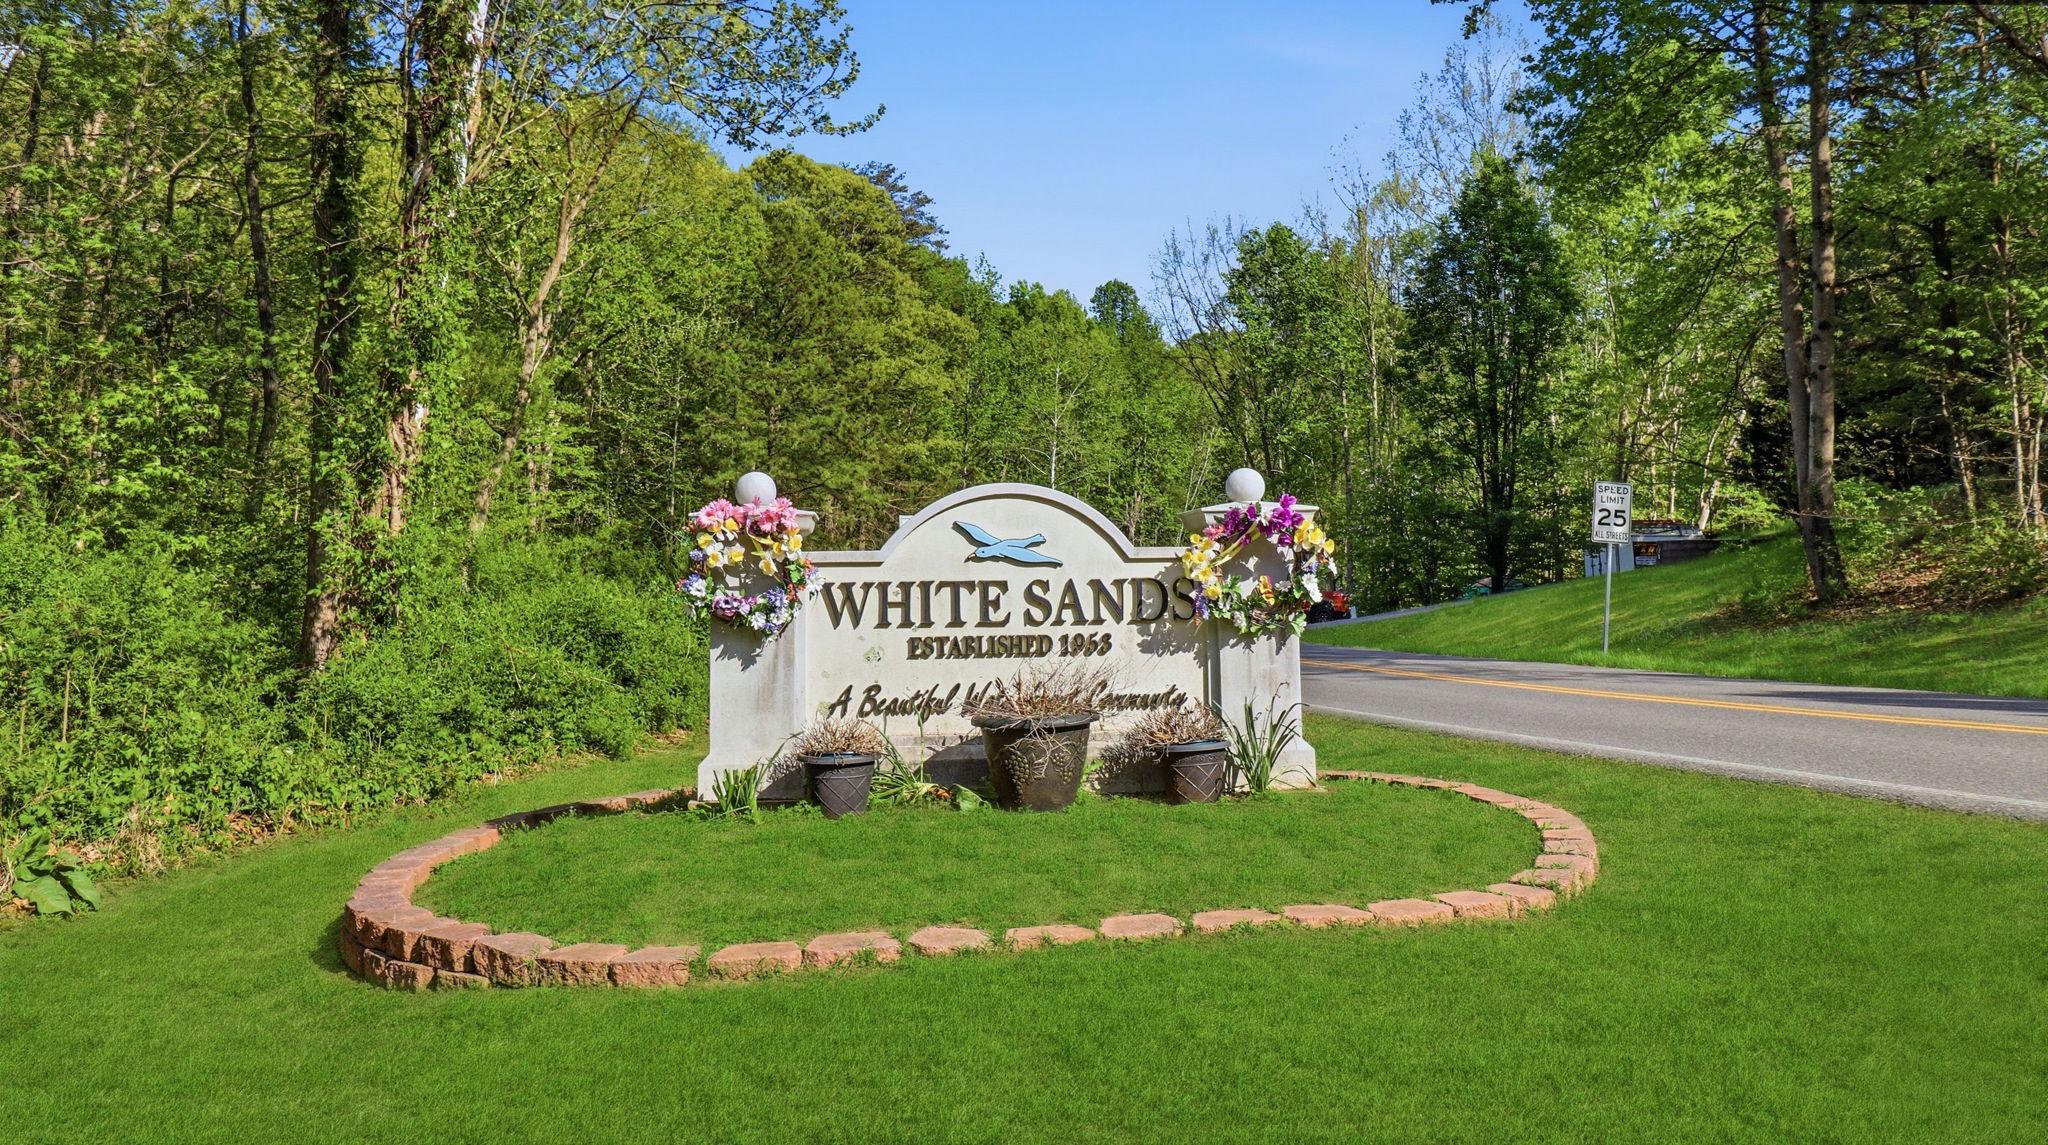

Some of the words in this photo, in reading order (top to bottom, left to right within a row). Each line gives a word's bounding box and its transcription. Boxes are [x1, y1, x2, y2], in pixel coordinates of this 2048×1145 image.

[1598, 485, 1629, 495] SPEED
[1600, 496, 1625, 504] LIMIT
[1597, 508, 1627, 526] 25
[1595, 531, 1604, 539] ALL
[1606, 531, 1629, 541] STREETS
[819, 580, 1011, 630] WHITE
[1023, 576, 1198, 627] SANDS
[907, 635, 1053, 660] ESTABLISHED
[826, 684, 853, 719] A
[857, 683, 961, 724] Beautiful
